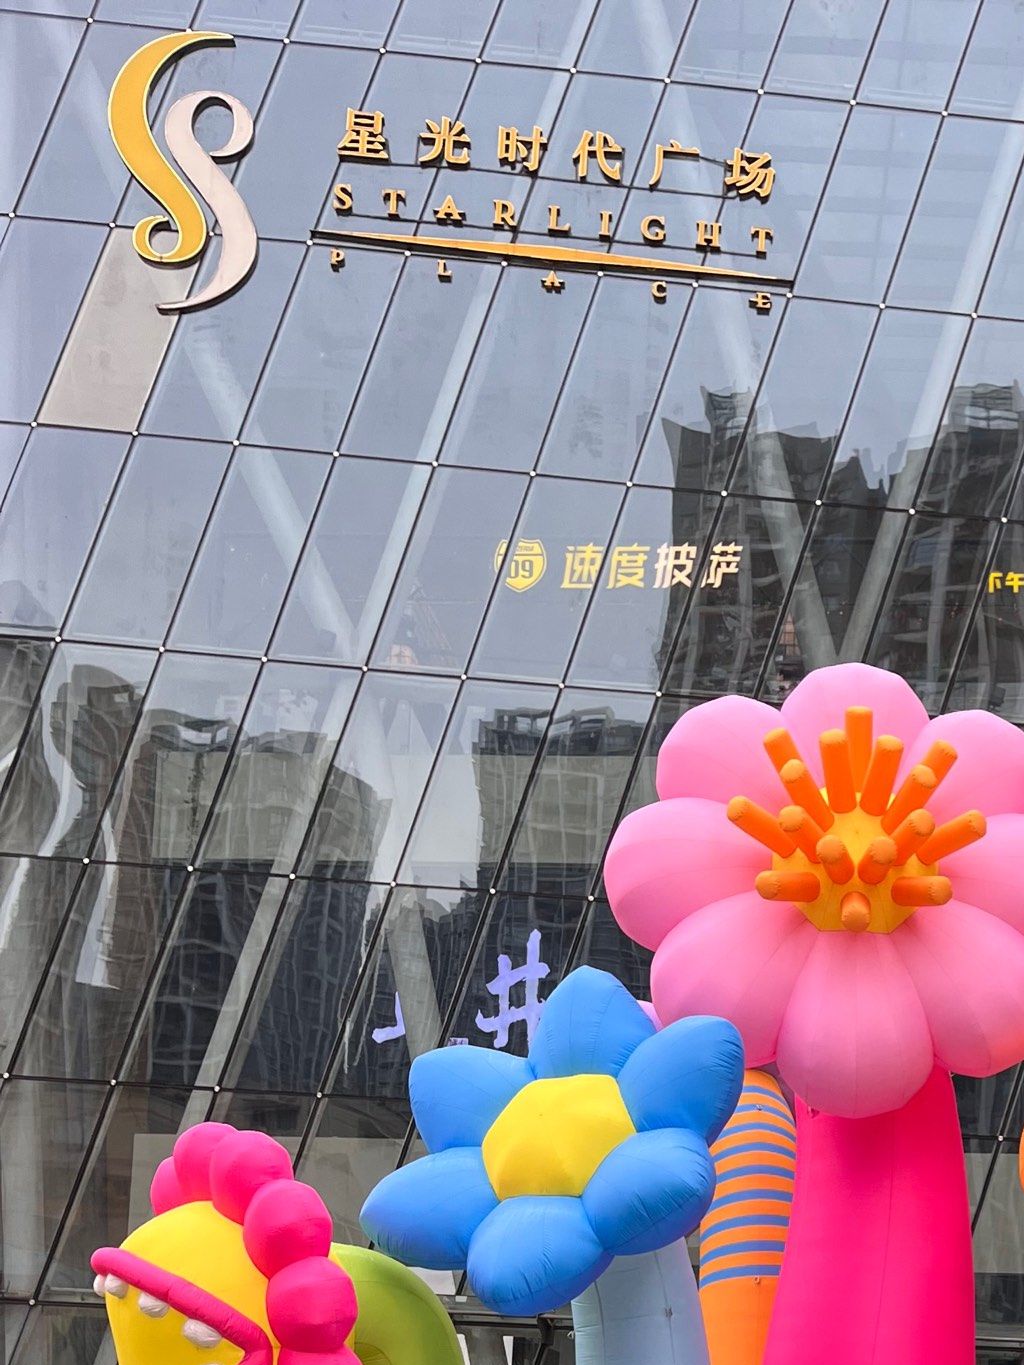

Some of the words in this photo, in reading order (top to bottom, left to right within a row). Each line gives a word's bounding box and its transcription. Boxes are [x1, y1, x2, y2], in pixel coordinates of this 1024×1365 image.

[338, 108, 776, 198] 星光时代广场
[333, 184, 774, 257] STARLIGHT
[330, 249, 772, 310] PLACE
[560, 541, 744, 589] 速度披萨
